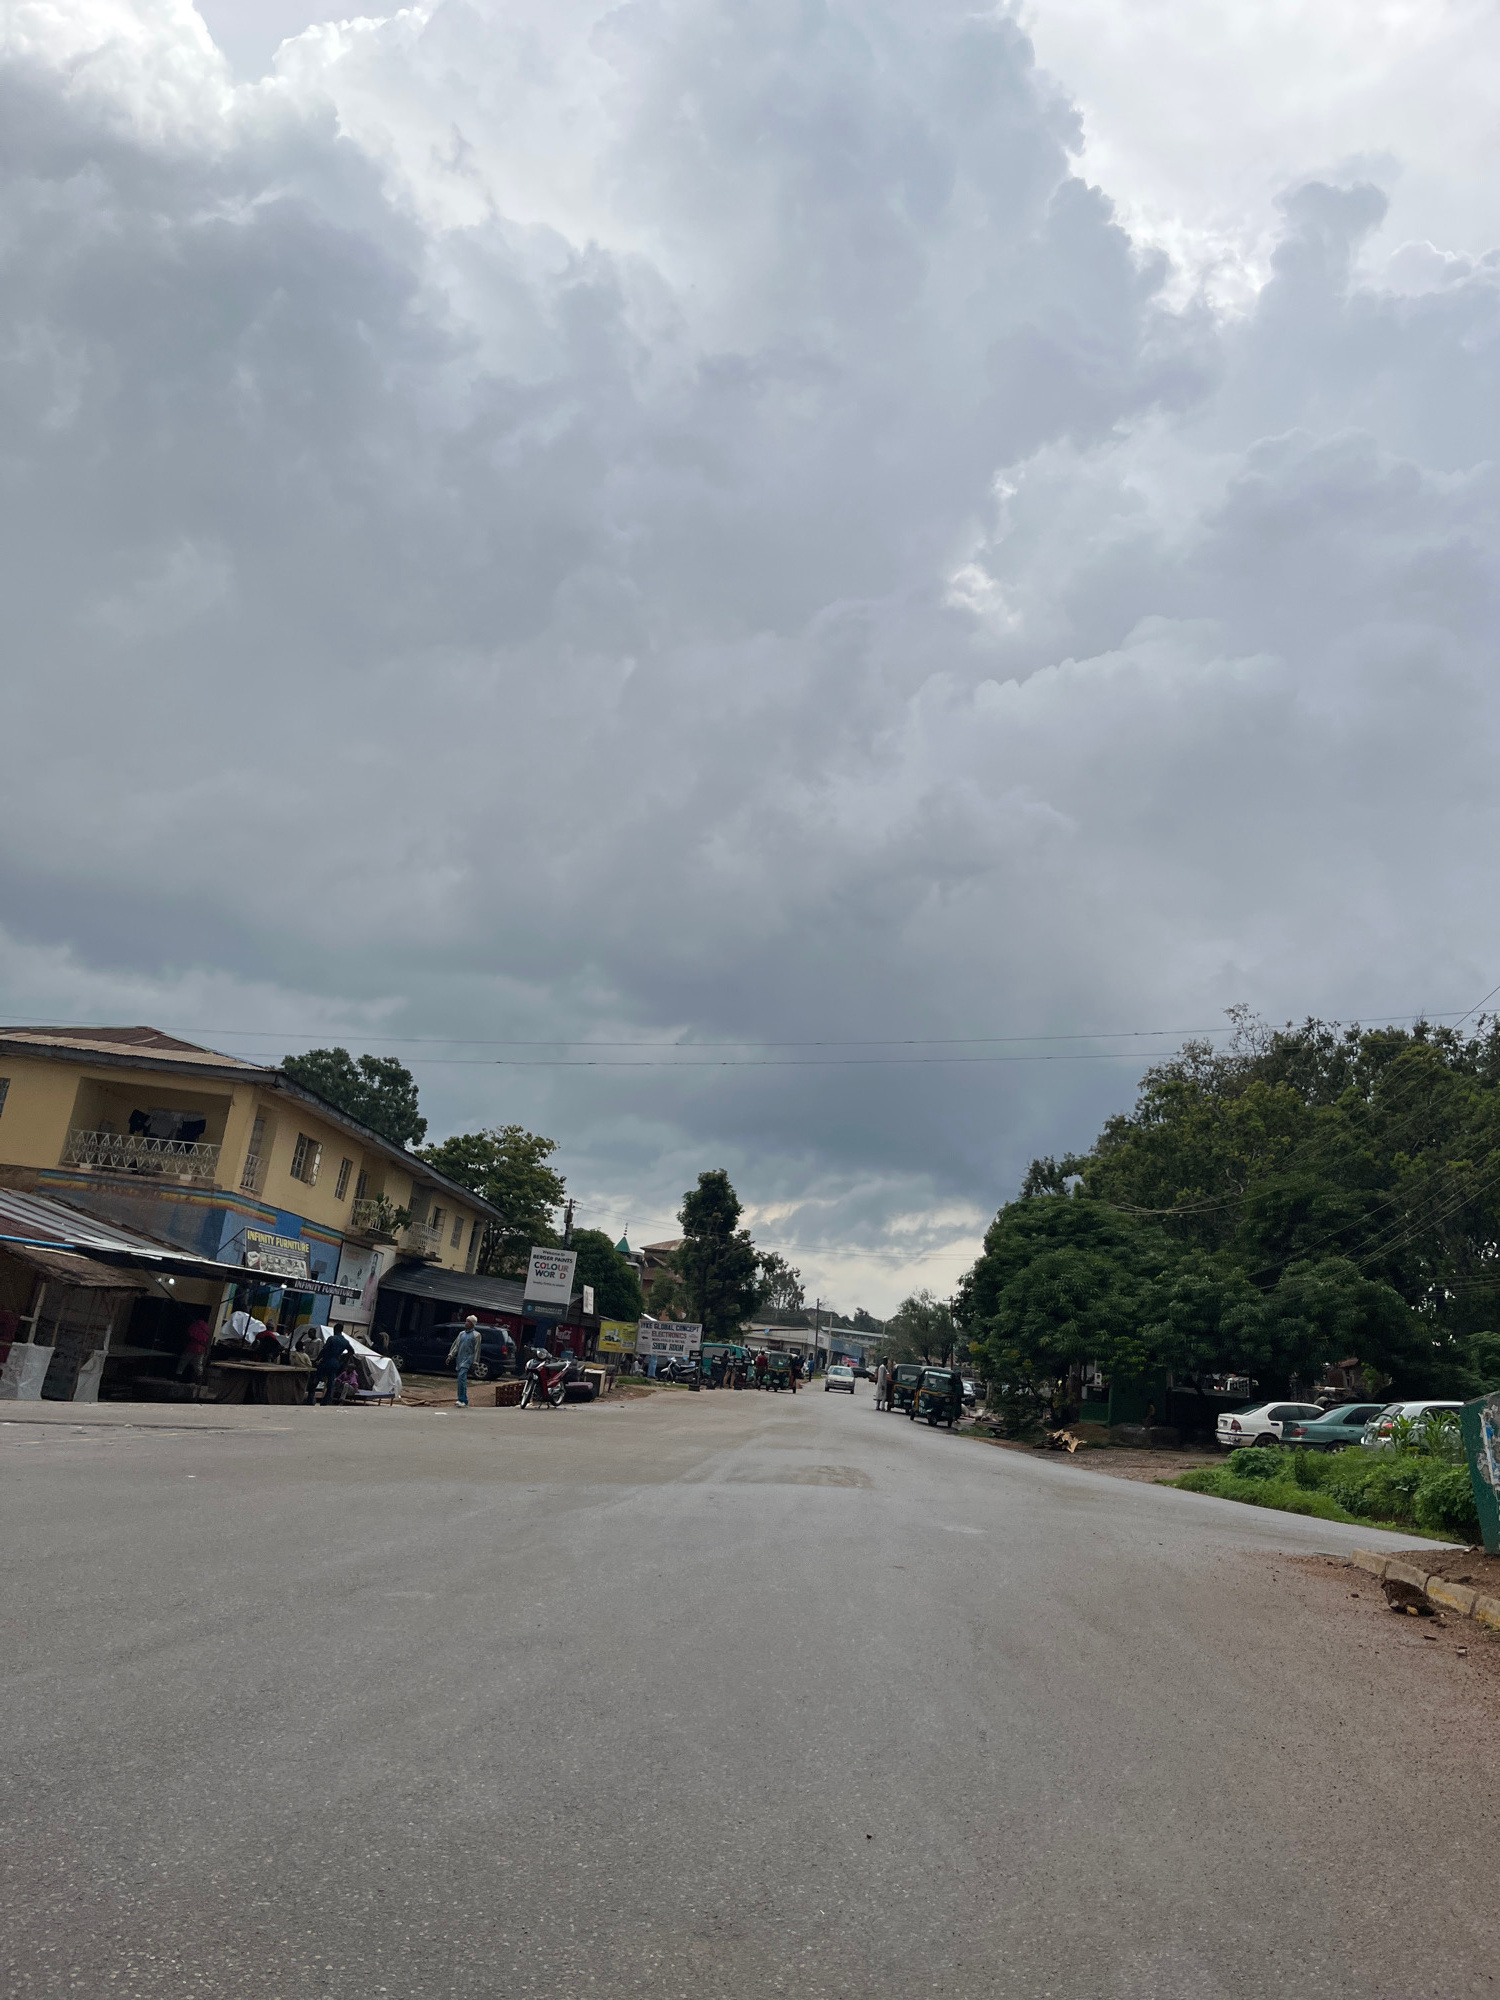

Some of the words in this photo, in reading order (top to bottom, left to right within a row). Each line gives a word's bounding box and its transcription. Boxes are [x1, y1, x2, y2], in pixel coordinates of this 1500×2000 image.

[247, 1229, 275, 1246] INFINITY
[275, 1237, 310, 1253] FURNITURE
[534, 1261, 569, 1272] COLOUR
[535, 1269, 566, 1280] WORD
[294, 1280, 321, 1292] INFINITY
[321, 1285, 354, 1298] FURNITURE
[654, 1323, 675, 1331] GLOBAL
[675, 1325, 700, 1333] CONCEPT
[652, 1331, 687, 1339] ELECTRONICS
[652, 1342, 667, 1350] SHOW
[669, 1344, 685, 1352] ROOM
